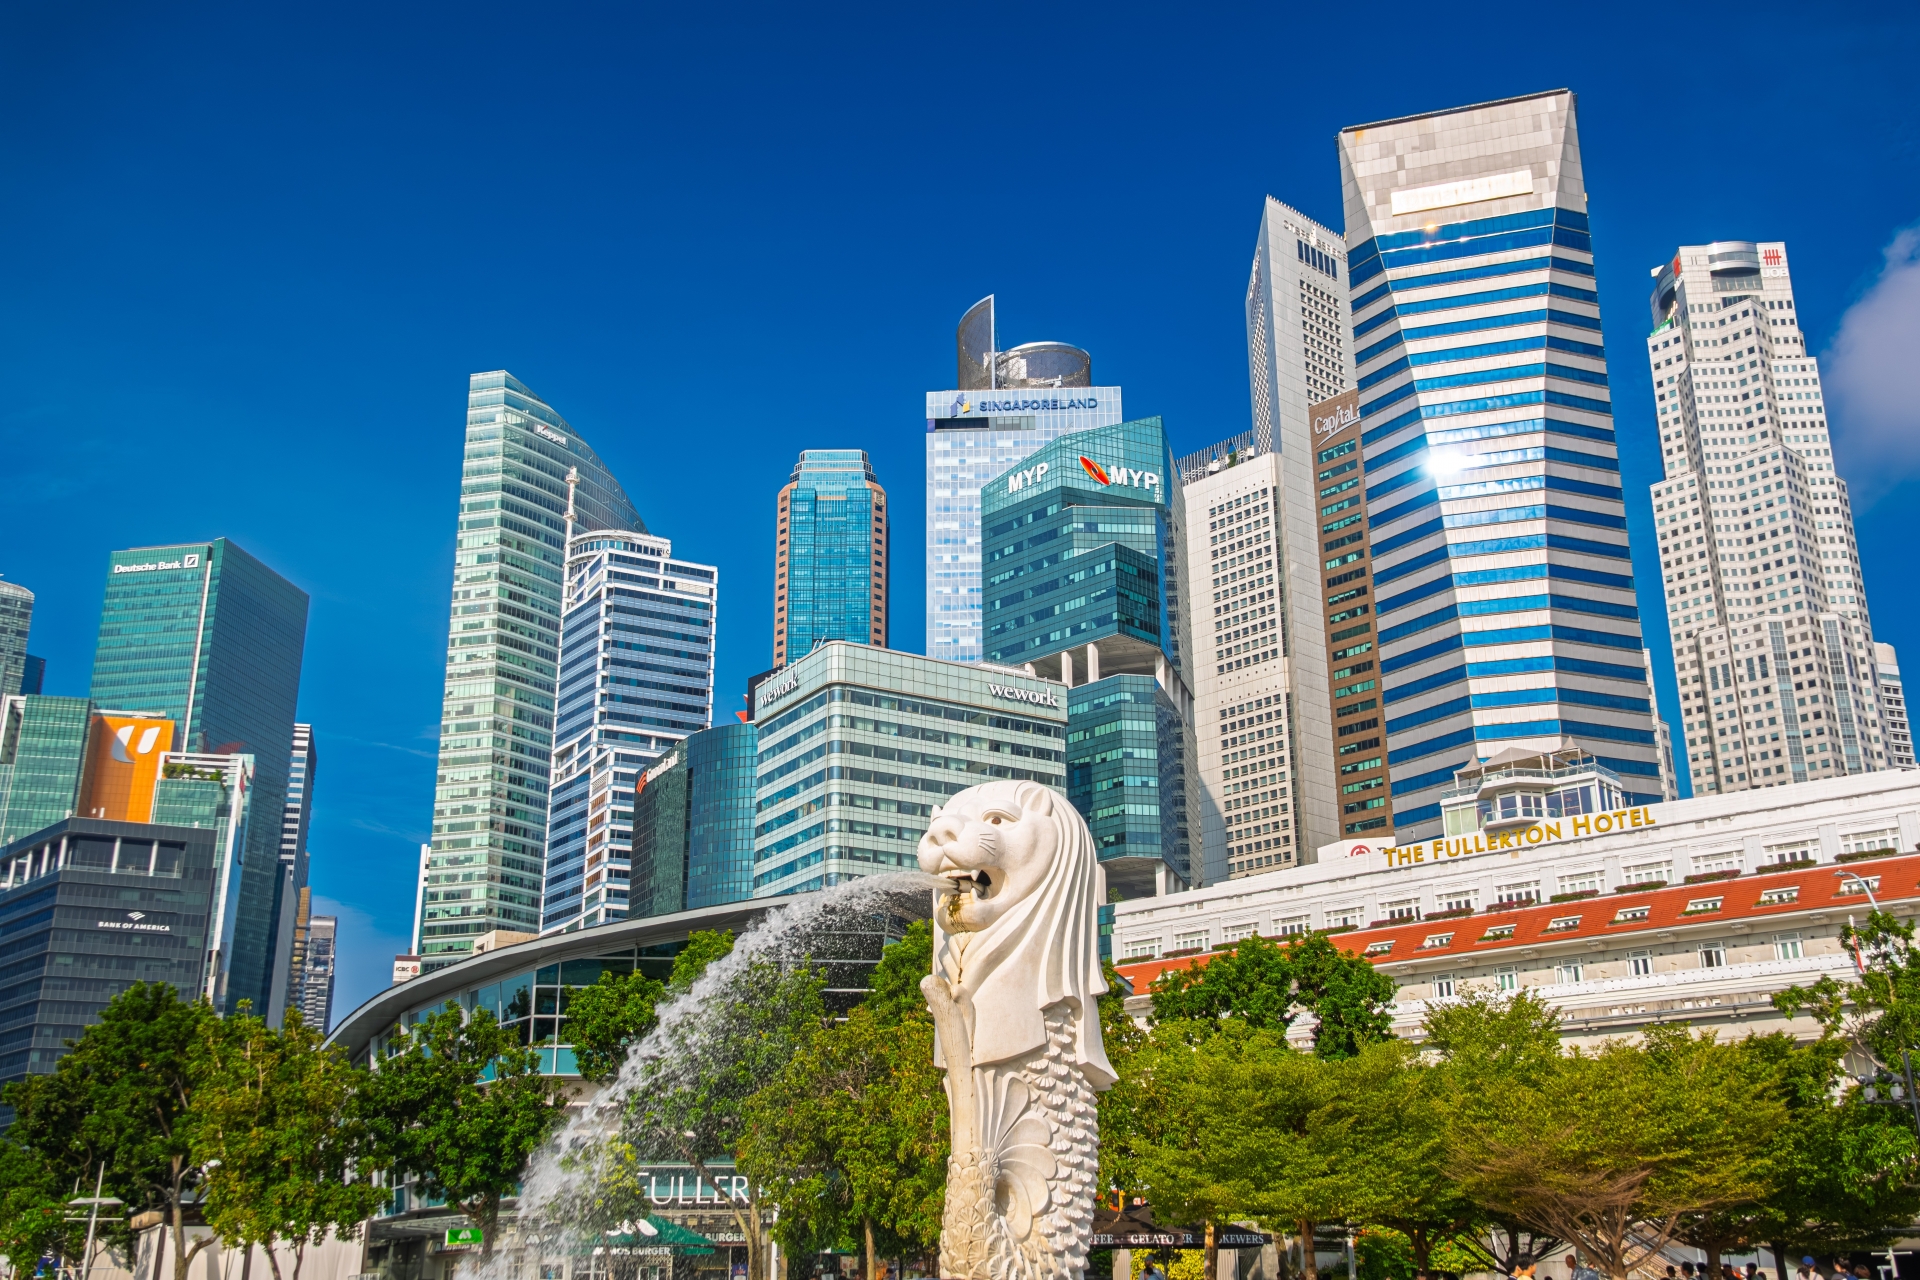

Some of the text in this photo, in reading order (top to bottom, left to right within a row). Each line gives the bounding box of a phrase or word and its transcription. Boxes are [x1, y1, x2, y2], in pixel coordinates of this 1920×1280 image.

[1761, 268, 1789, 278] UOB
[979, 398, 1098, 411] SINGAPORELAND
[537, 424, 567, 445] Keppel
[1008, 462, 1049, 494] MYP
[1110, 465, 1159, 490] MYP
[114, 560, 182, 574] Deutsche Bank
[760, 670, 798, 707] wework
[987, 683, 1059, 707] wework
[1383, 806, 1656, 868] THE FULLERTON HOTEL
[97, 921, 171, 932] BANK OF AMERICA
[704, 1231, 747, 1242] BURGER
[1130, 1233, 1175, 1244] GELATO
[632, 1245, 671, 1256] BURGER
